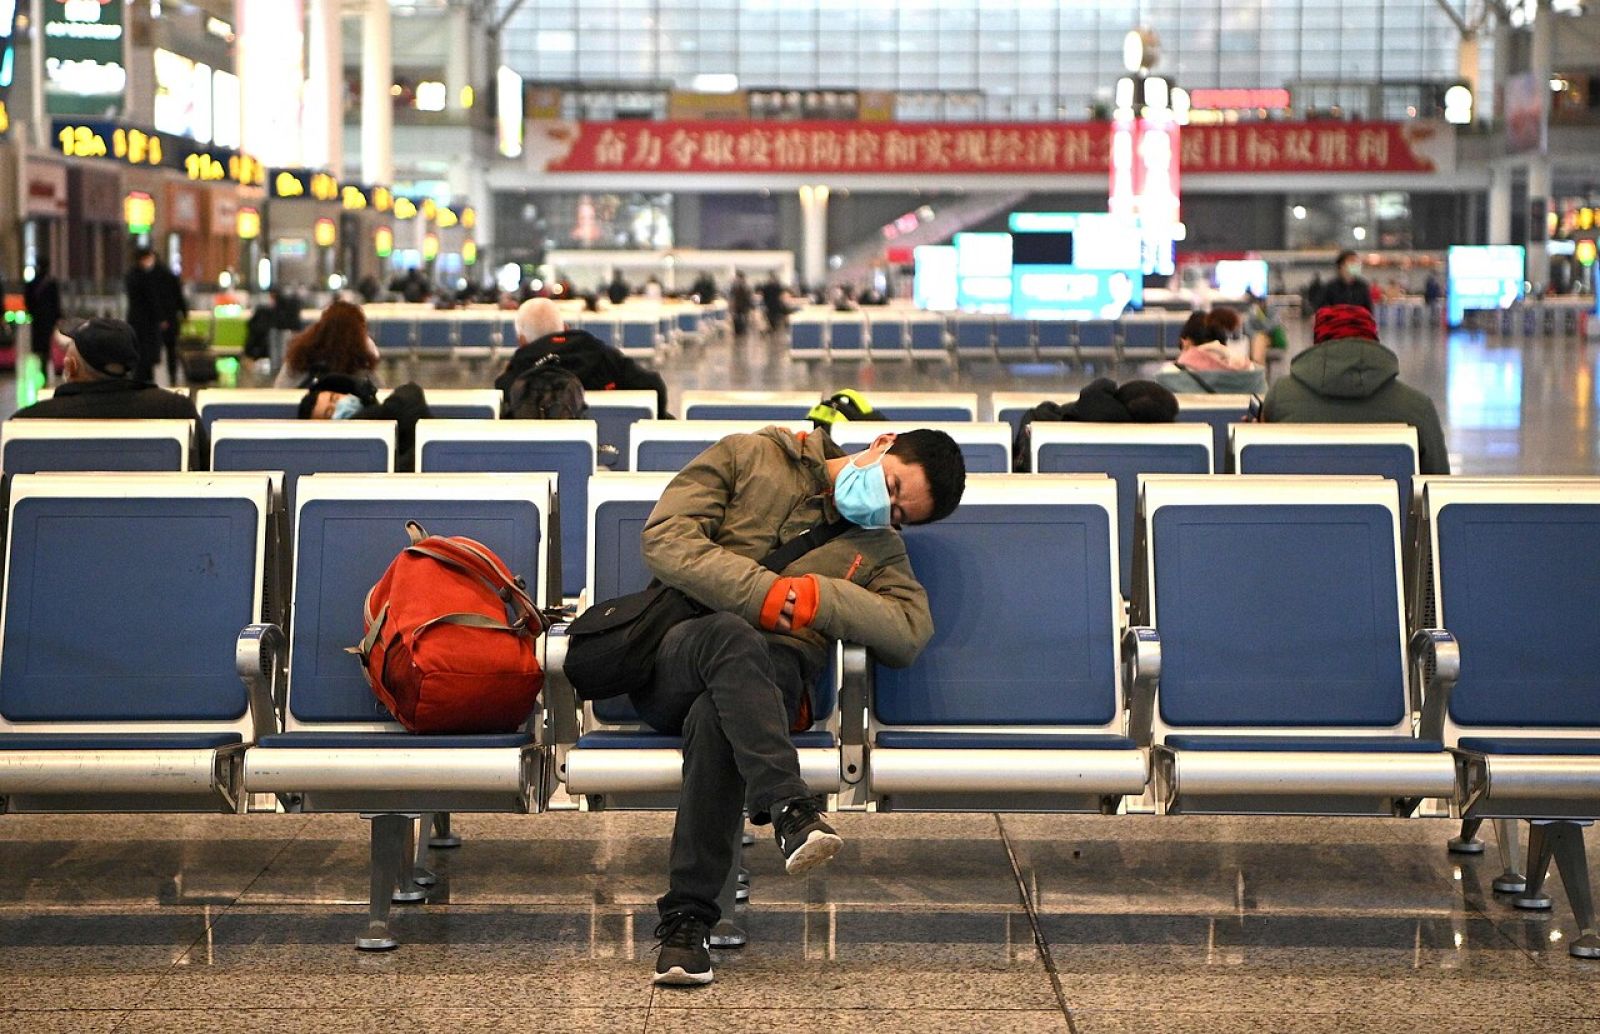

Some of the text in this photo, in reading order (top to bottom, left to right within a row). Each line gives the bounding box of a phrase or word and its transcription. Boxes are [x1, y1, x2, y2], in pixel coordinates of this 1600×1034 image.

[595, 128, 1389, 168] 奋力夺取疫情防控和实现经济社展目标双胜利
